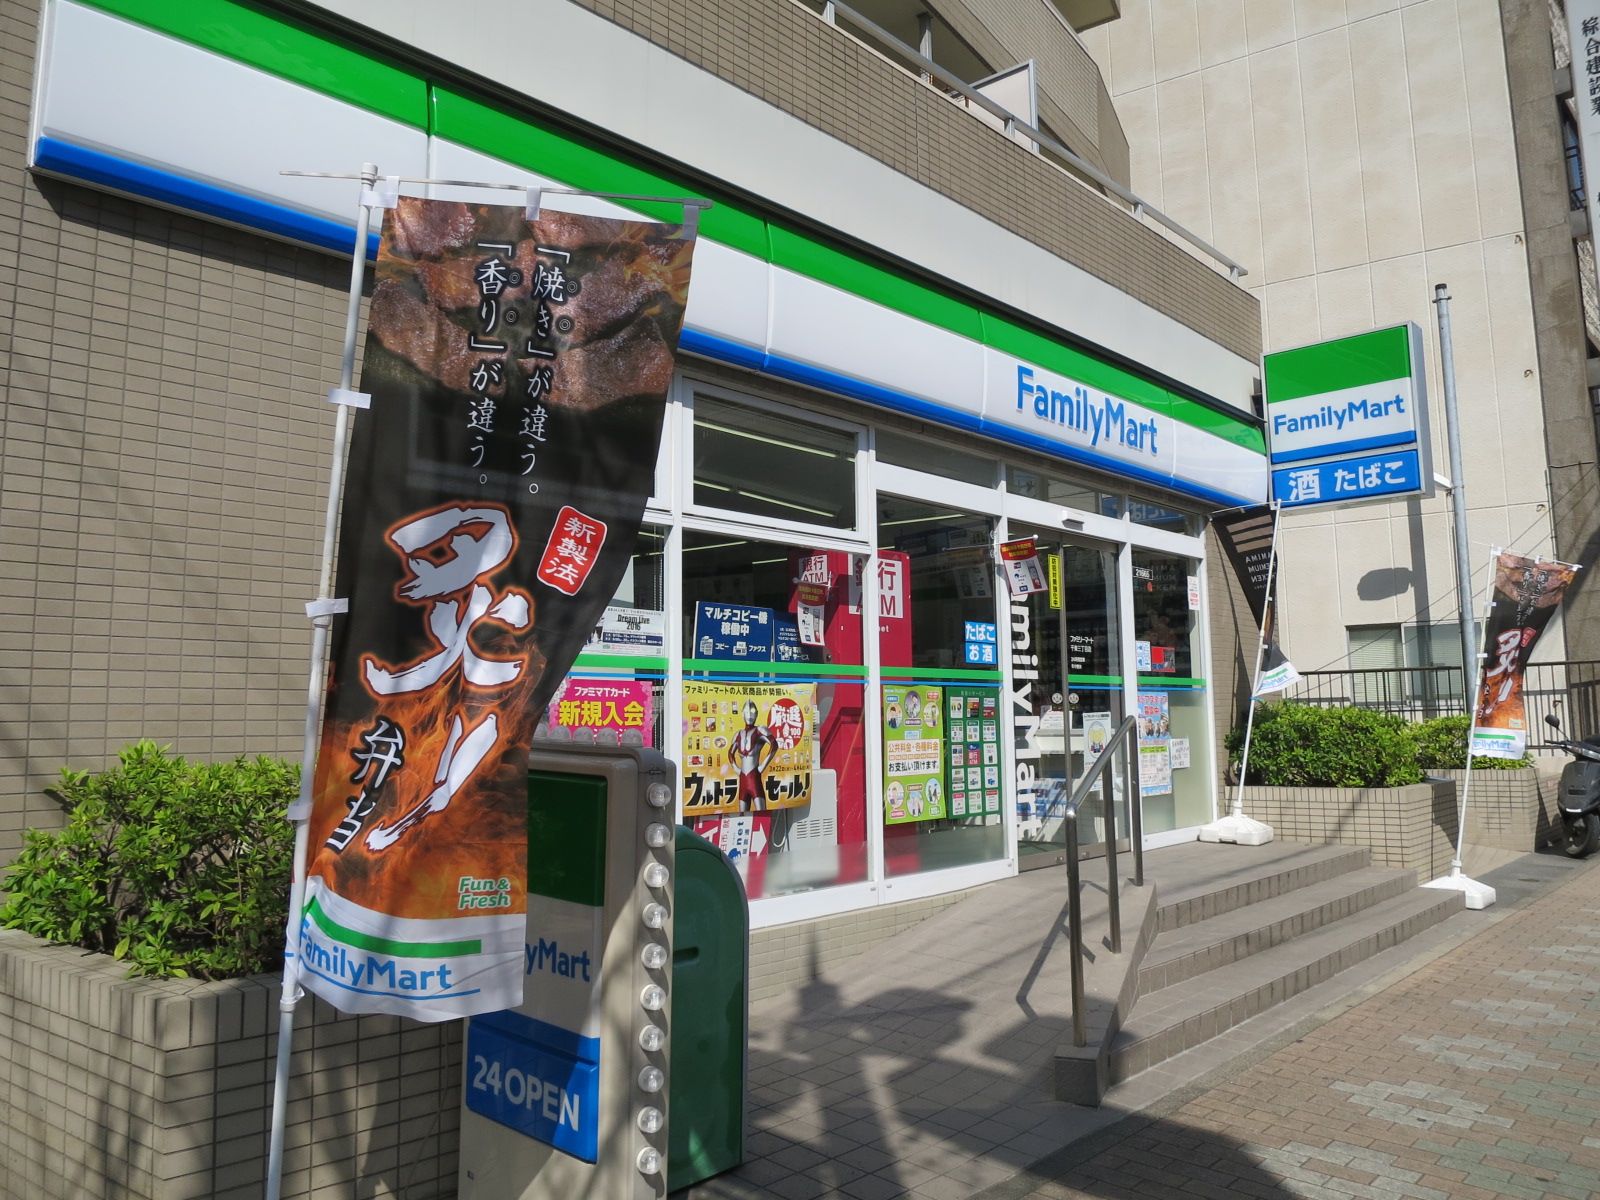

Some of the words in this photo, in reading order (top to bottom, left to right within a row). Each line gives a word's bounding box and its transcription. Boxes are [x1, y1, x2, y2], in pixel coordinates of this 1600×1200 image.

[1016, 363, 1158, 455] FamilyMart
[1273, 393, 1406, 436] FamilyMart
[1288, 468, 1321, 502] 酒
[1334, 460, 1406, 492] たばこ
[545, 515, 596, 587] 新製法
[617, 614, 638, 623] Dream
[704, 606, 768, 625] マルチコピー機
[626, 621, 641, 631] 2016
[720, 621, 750, 637] 稼働中
[965, 623, 996, 641] たばこ
[715, 643, 730, 651] コピー
[969, 644, 993, 662] お酒
[574, 686, 631, 698] ファミマTカード
[559, 700, 645, 727] 新規入会
[326, 720, 402, 850] 弁当
[684, 772, 738, 807] ウルトラ
[765, 772, 811, 802] セール!
[459, 876, 495, 893] Fun
[497, 877, 510, 892] &
[458, 893, 510, 910] Fresh
[300, 916, 453, 991] FamilyMart
